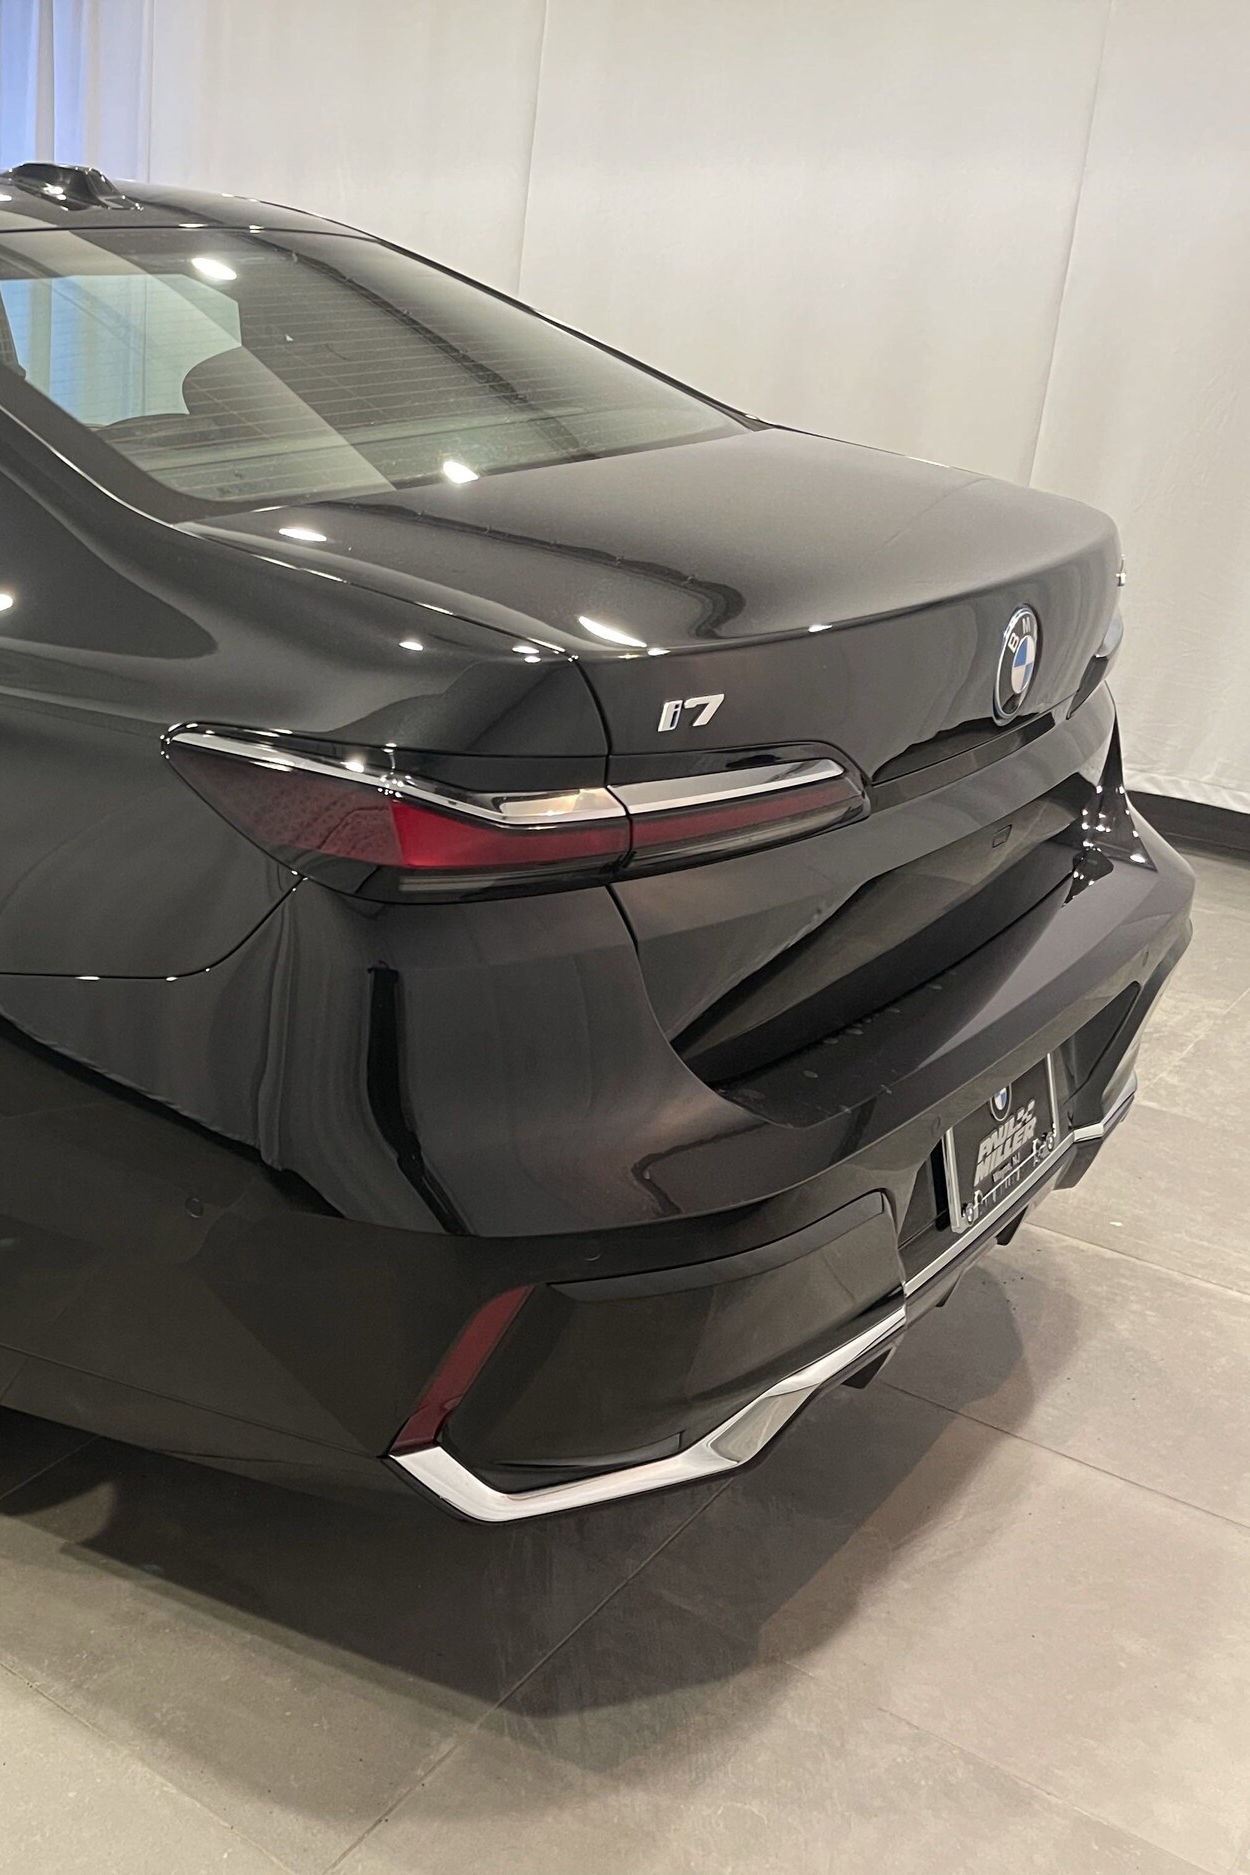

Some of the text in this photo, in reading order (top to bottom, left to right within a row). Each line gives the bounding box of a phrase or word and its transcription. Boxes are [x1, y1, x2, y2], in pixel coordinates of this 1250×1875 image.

[658, 693, 724, 732] i7
[974, 1117, 1036, 1186] MILLER
[978, 1117, 1021, 1164] PAUL
